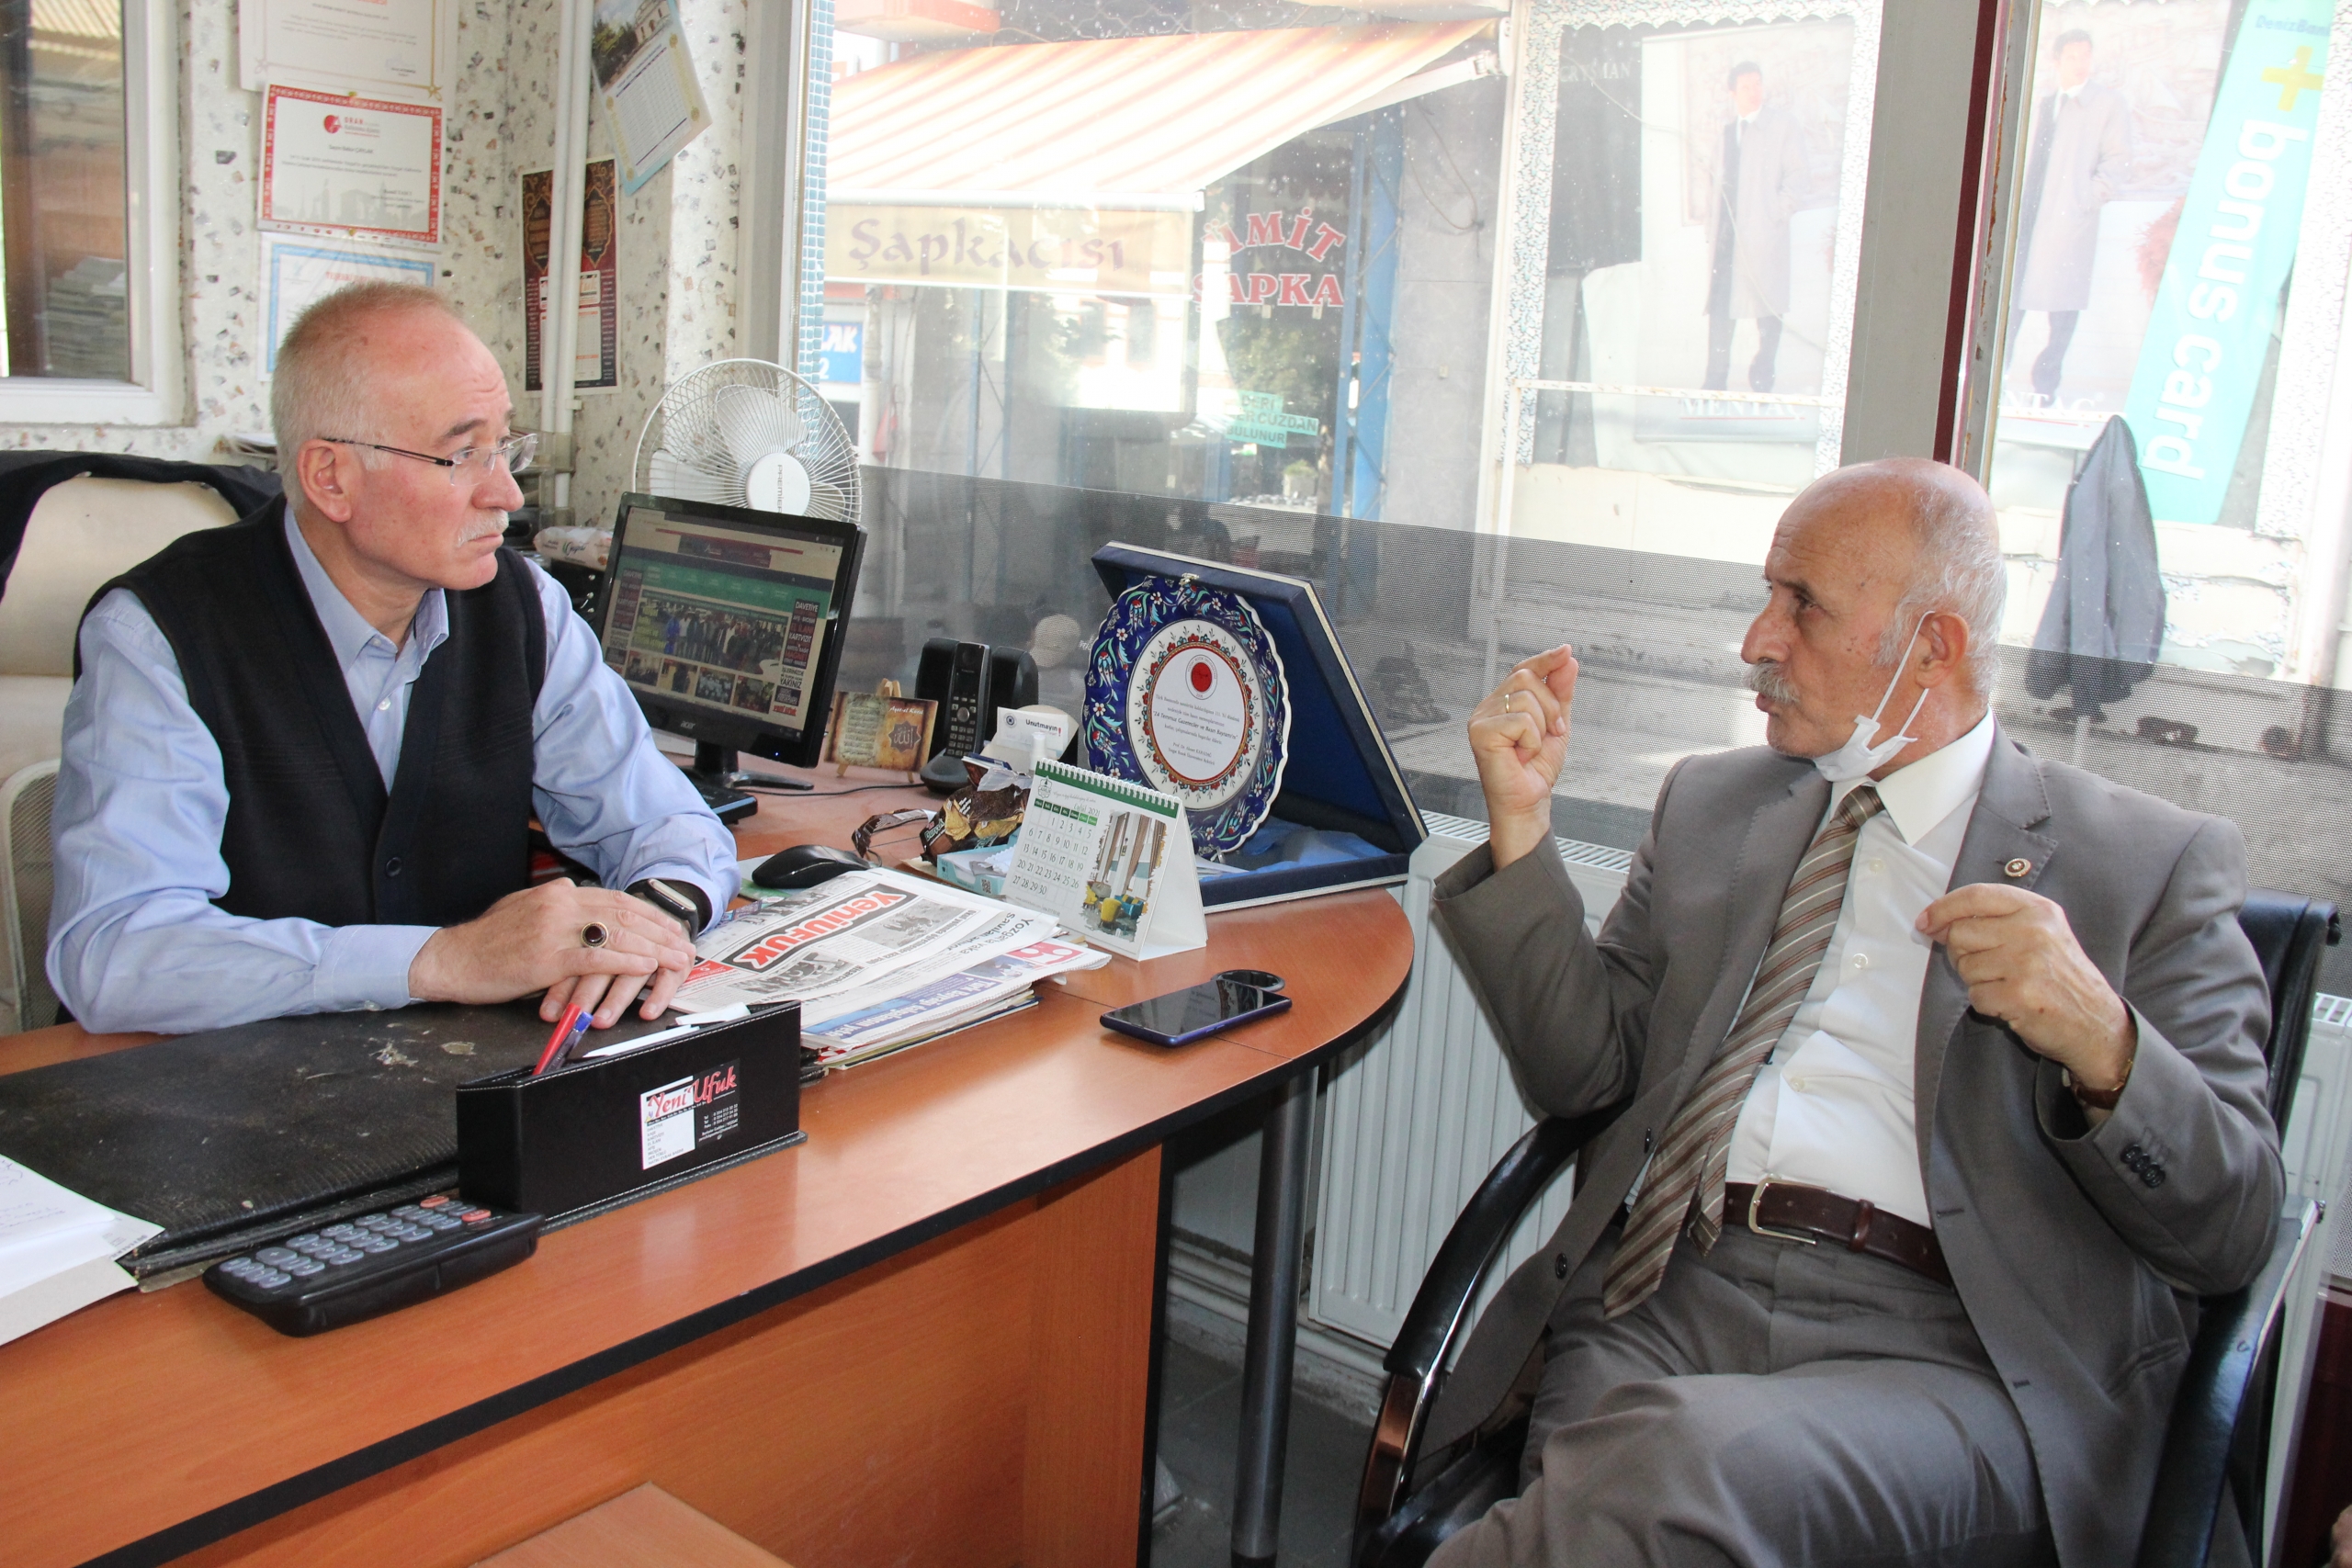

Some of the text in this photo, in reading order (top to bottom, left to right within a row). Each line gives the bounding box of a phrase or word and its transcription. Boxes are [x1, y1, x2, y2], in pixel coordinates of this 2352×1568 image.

[848, 216, 1125, 276] Şapkacısı
[2139, 118, 2310, 481] bonus card
[1227, 426, 1285, 444] BULUNUR
[680, 720, 696, 729] acer
[1161, 712, 1177, 722] Temmuz
[1178, 717, 1199, 728] Gazeteciler
[1088, 807, 1100, 817] 2021
[1052, 818, 1055, 826] 1
[1060, 820, 1064, 829] 2
[1069, 824, 1073, 832] 3
[1087, 830, 1092, 838] 5
[1038, 831, 1042, 839] 7
[1046, 834, 1051, 843] 8
[1064, 840, 1070, 849] 10
[1082, 846, 1088, 855] 12
[1024, 844, 1083, 871] 13 14 15 16 17 18 19
[1013, 875, 1047, 895] 27 28 29 30
[1018, 859, 1079, 889] 20 21 22 23 24 25 26
[734, 891, 906, 970] YeniUFUK
[648, 1091, 688, 1118] Yeni
[686, 1066, 738, 1103] Ufuk
